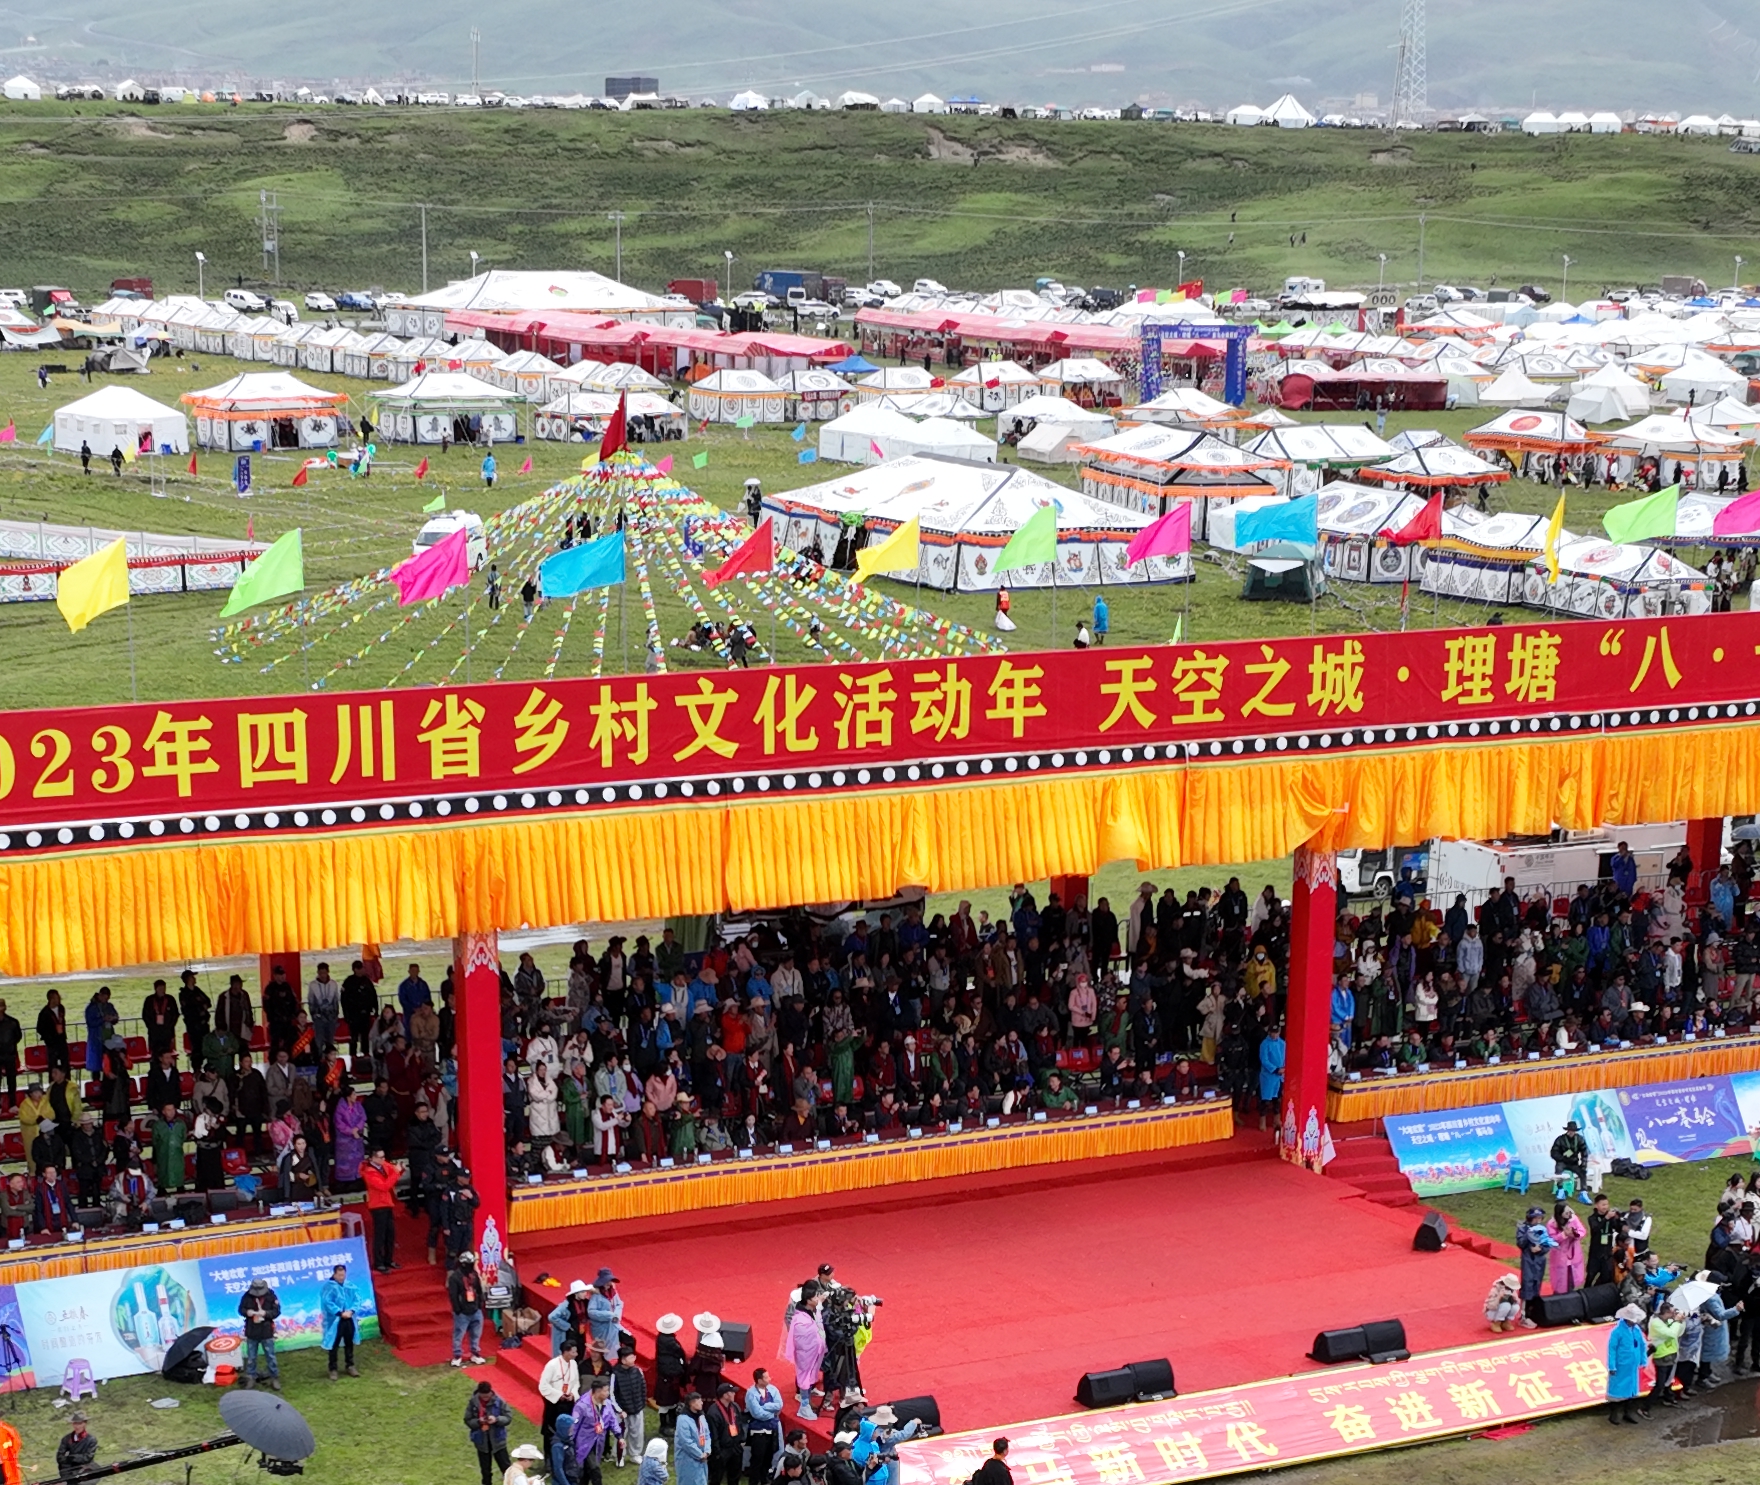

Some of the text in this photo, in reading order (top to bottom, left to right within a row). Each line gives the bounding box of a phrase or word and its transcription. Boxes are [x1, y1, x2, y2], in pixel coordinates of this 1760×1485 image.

[1323, 1358, 1608, 1443] 奋进新征程
